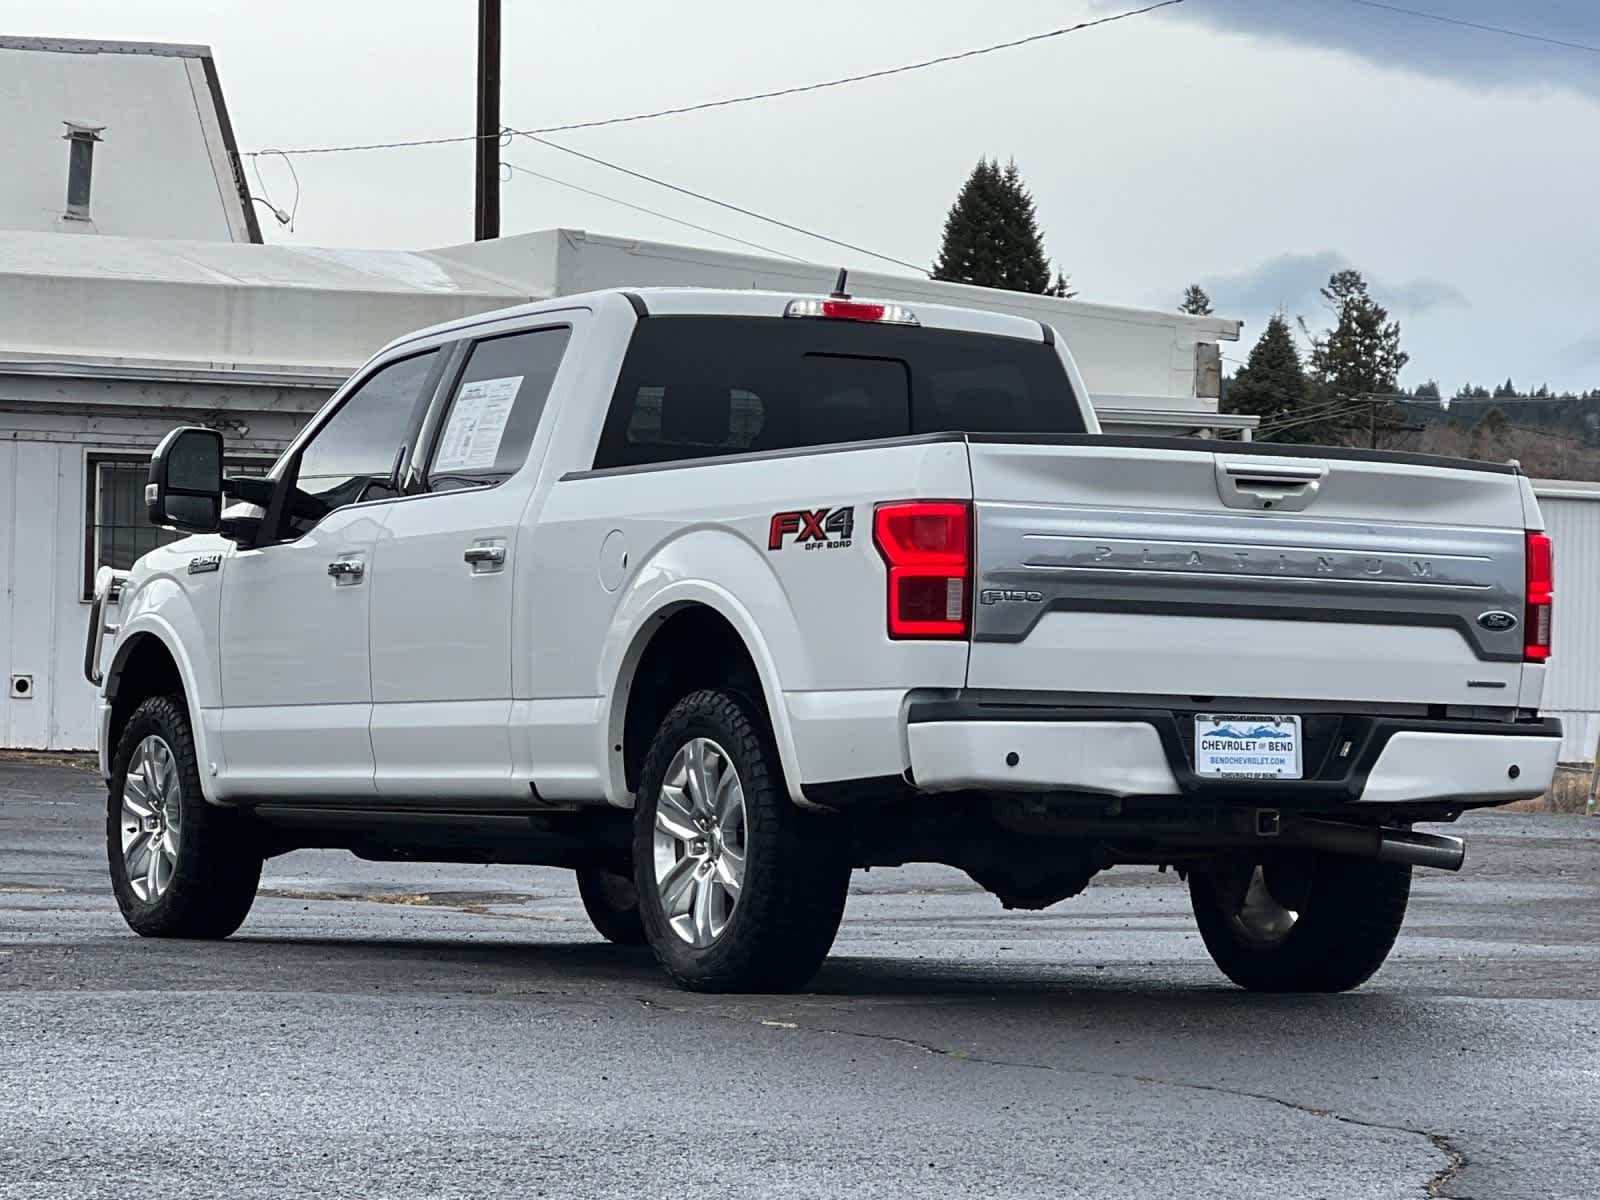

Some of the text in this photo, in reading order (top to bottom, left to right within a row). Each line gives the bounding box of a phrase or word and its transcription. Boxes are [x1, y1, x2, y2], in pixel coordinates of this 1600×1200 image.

[768, 506, 854, 551] FX4
[805, 541, 852, 550] OFF ROAD
[1095, 546, 1432, 577] PLATINUM
[1201, 740, 1257, 751] CHEVROLET
[1268, 742, 1293, 752] BEND
[1210, 756, 1285, 765] BENDCHEVROLET.COM
